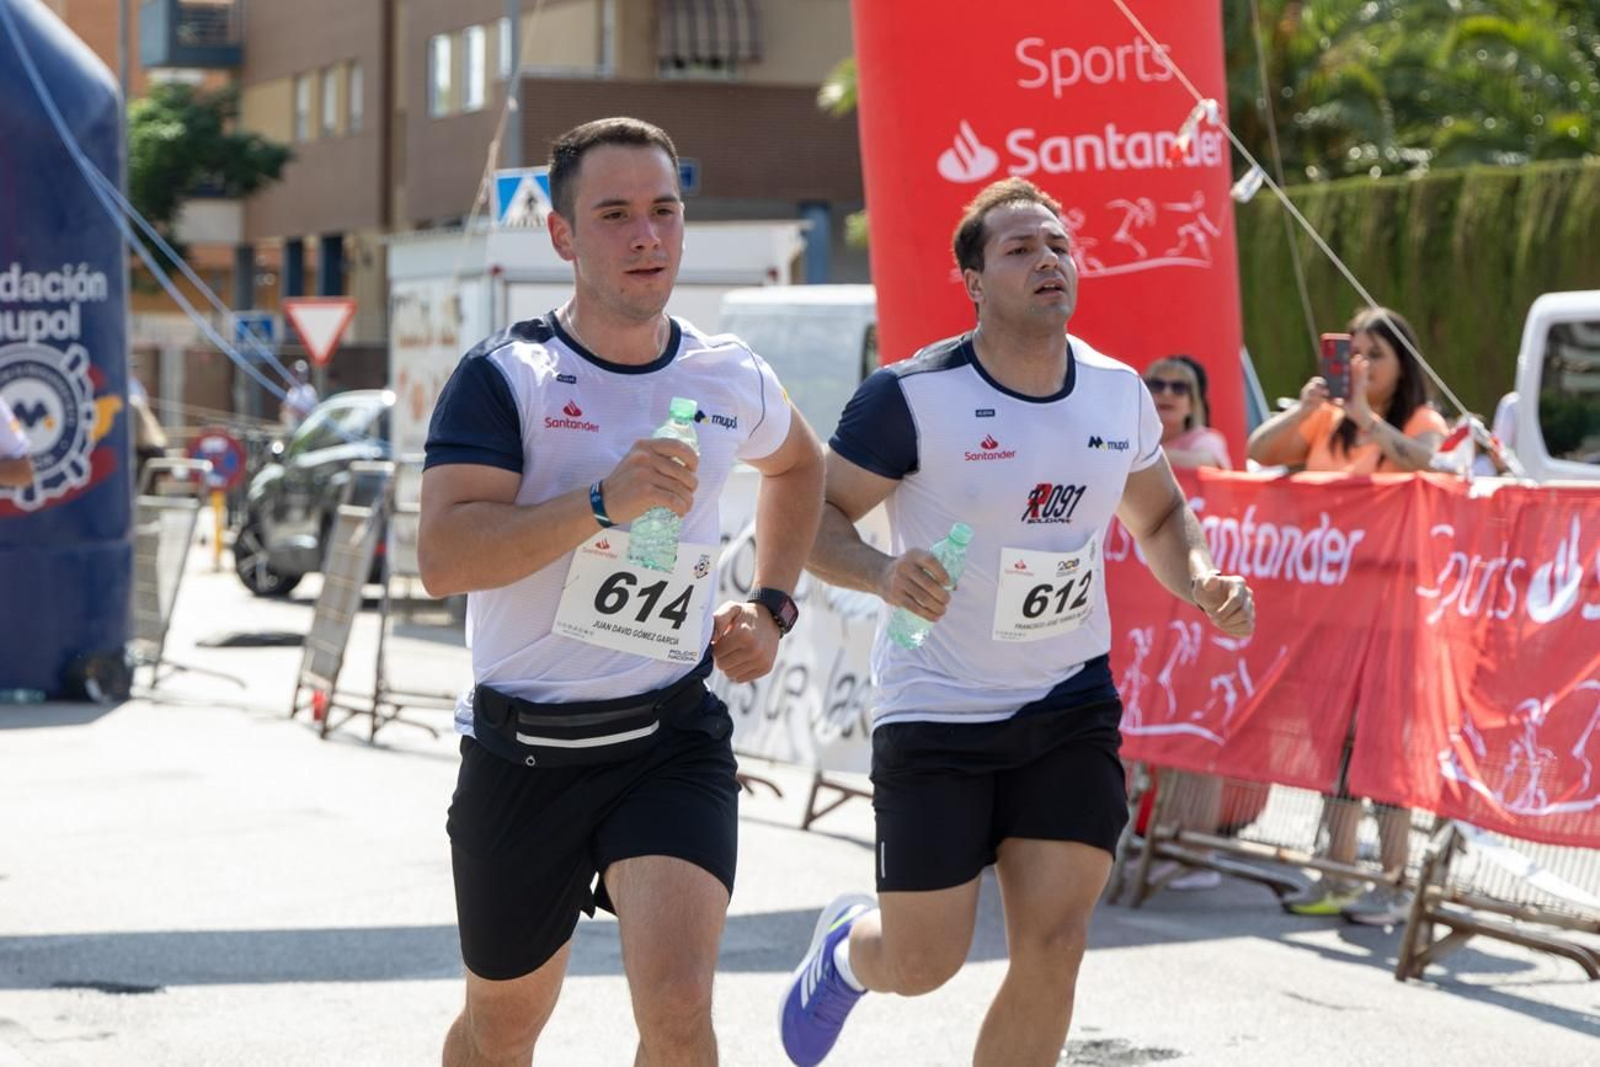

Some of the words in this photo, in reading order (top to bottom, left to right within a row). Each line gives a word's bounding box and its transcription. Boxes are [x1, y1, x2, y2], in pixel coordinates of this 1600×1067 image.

[1014, 35, 1172, 99] Sports
[544, 416, 600, 433] Santander
[964, 449, 1016, 461] Santander
[1188, 497, 1366, 586] antander
[594, 571, 694, 630] 614
[1022, 569, 1092, 619] 612
[592, 619, 611, 631] JUAN
[612, 624, 632, 636] DAVID
